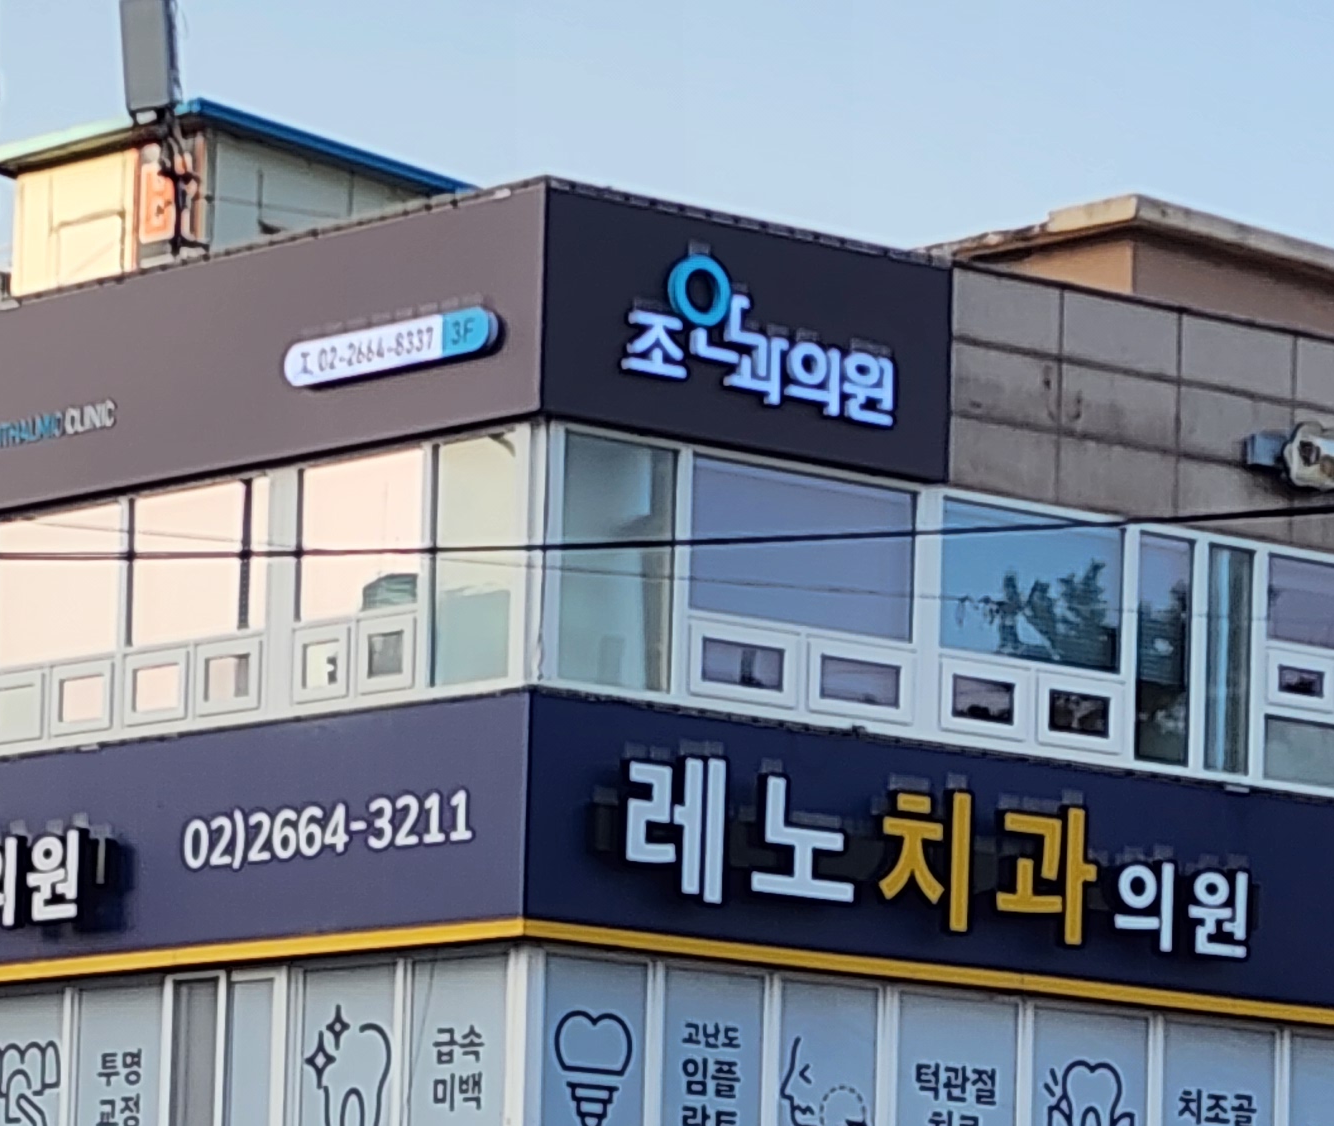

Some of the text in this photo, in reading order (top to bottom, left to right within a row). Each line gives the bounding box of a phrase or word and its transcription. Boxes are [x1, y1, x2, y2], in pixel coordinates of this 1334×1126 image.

[450, 317, 477, 349] 3F
[65, 399, 117, 435] CLINIC
[182, 789, 475, 871] 02)2664-3211
[625, 756, 1250, 958] 레노치과의원
[432, 1024, 485, 1066] 급속
[682, 1021, 743, 1051] 고난도
[96, 1049, 144, 1088] 투명
[682, 1057, 742, 1099] 임플
[915, 1062, 998, 1107] 턱관절
[432, 1072, 484, 1113] 미백
